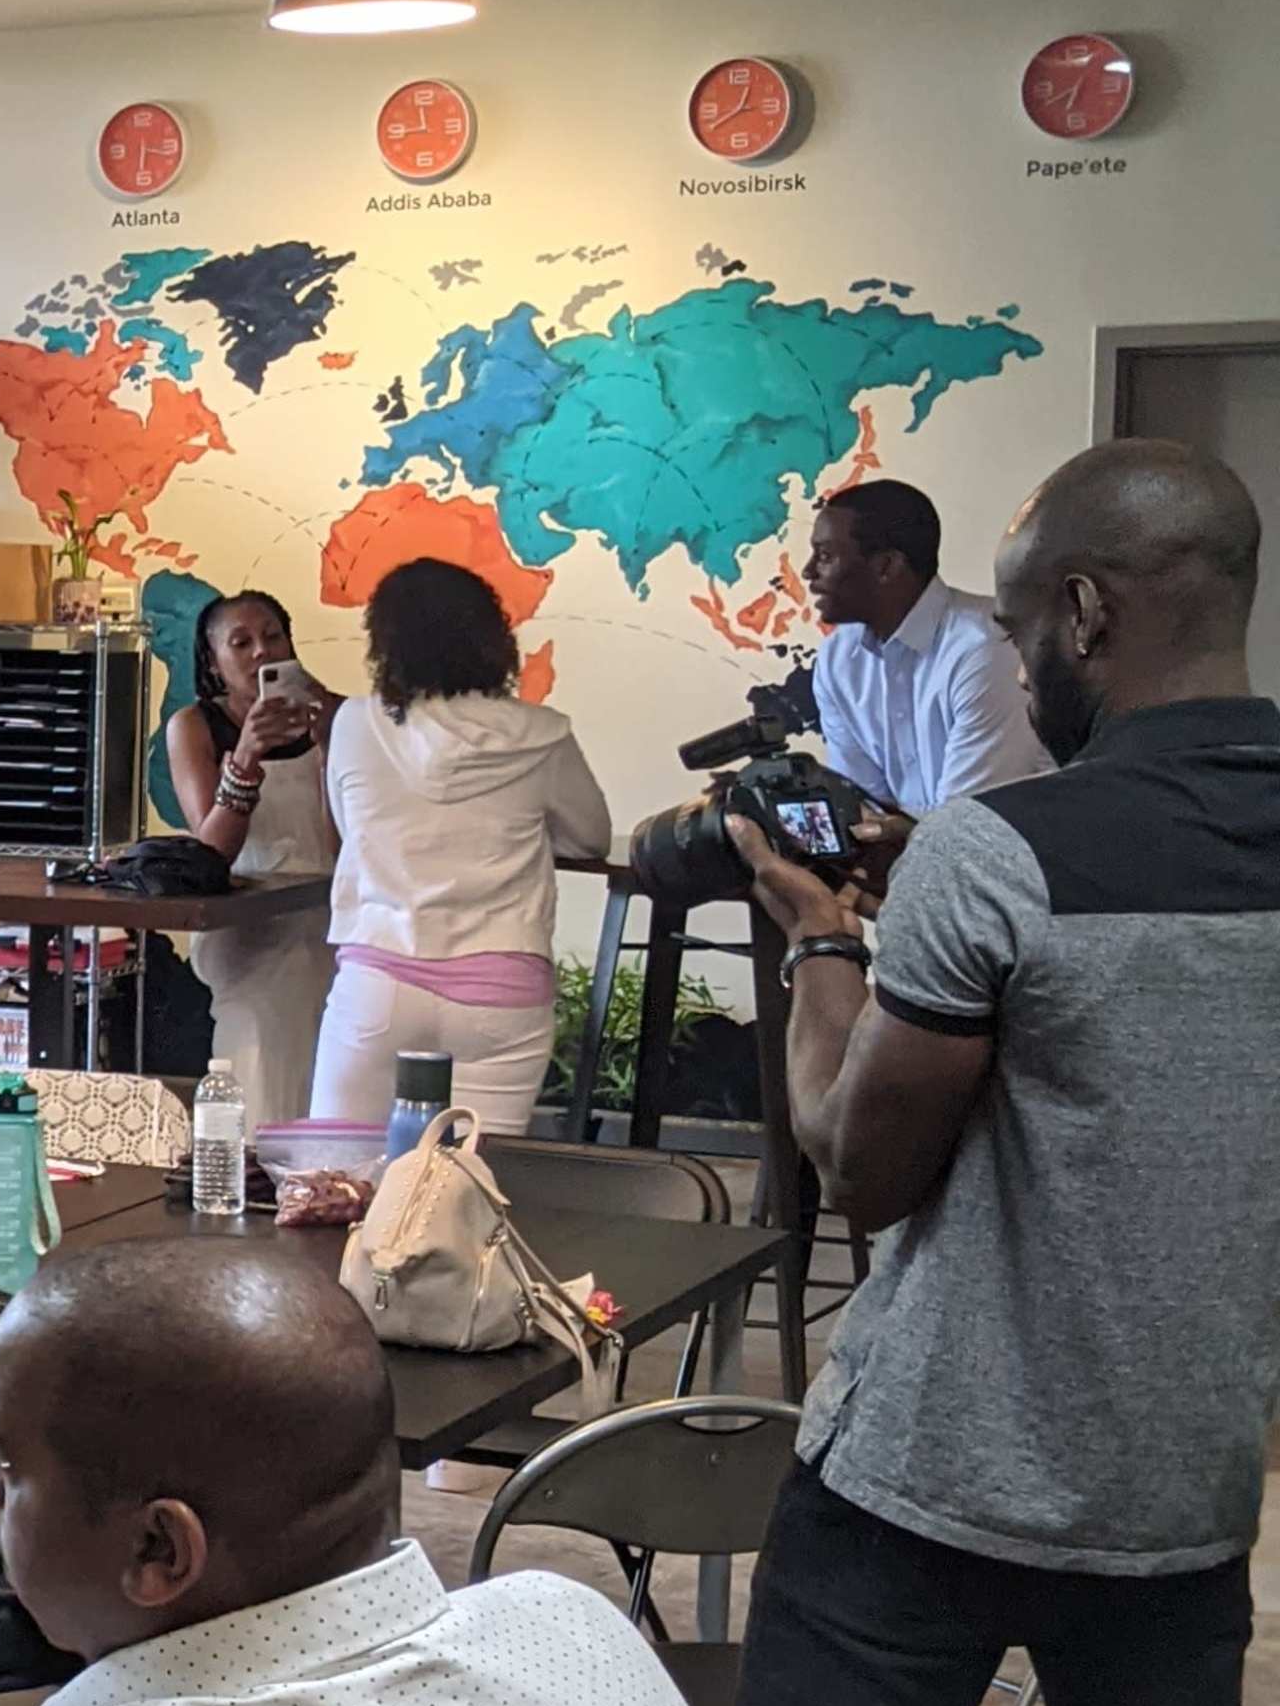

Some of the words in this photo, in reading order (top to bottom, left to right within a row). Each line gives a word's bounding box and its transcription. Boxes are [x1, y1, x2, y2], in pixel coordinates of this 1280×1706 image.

[729, 69, 750, 85] 12
[414, 90, 434, 106] 12
[761, 98, 780, 114] 3
[133, 112, 152, 128] 12
[444, 118, 461, 135] 3
[387, 123, 405, 139] 9
[163, 138, 178, 154] 3
[731, 133, 749, 148] 6
[110, 144, 126, 160] 9
[416, 152, 433, 167] 6
[136, 171, 152, 186] 6
[679, 172, 807, 197] Novosibirsk
[365, 193, 422, 213] Addis
[427, 190, 493, 209] Ababa
[111, 209, 181, 228] Atlanta
